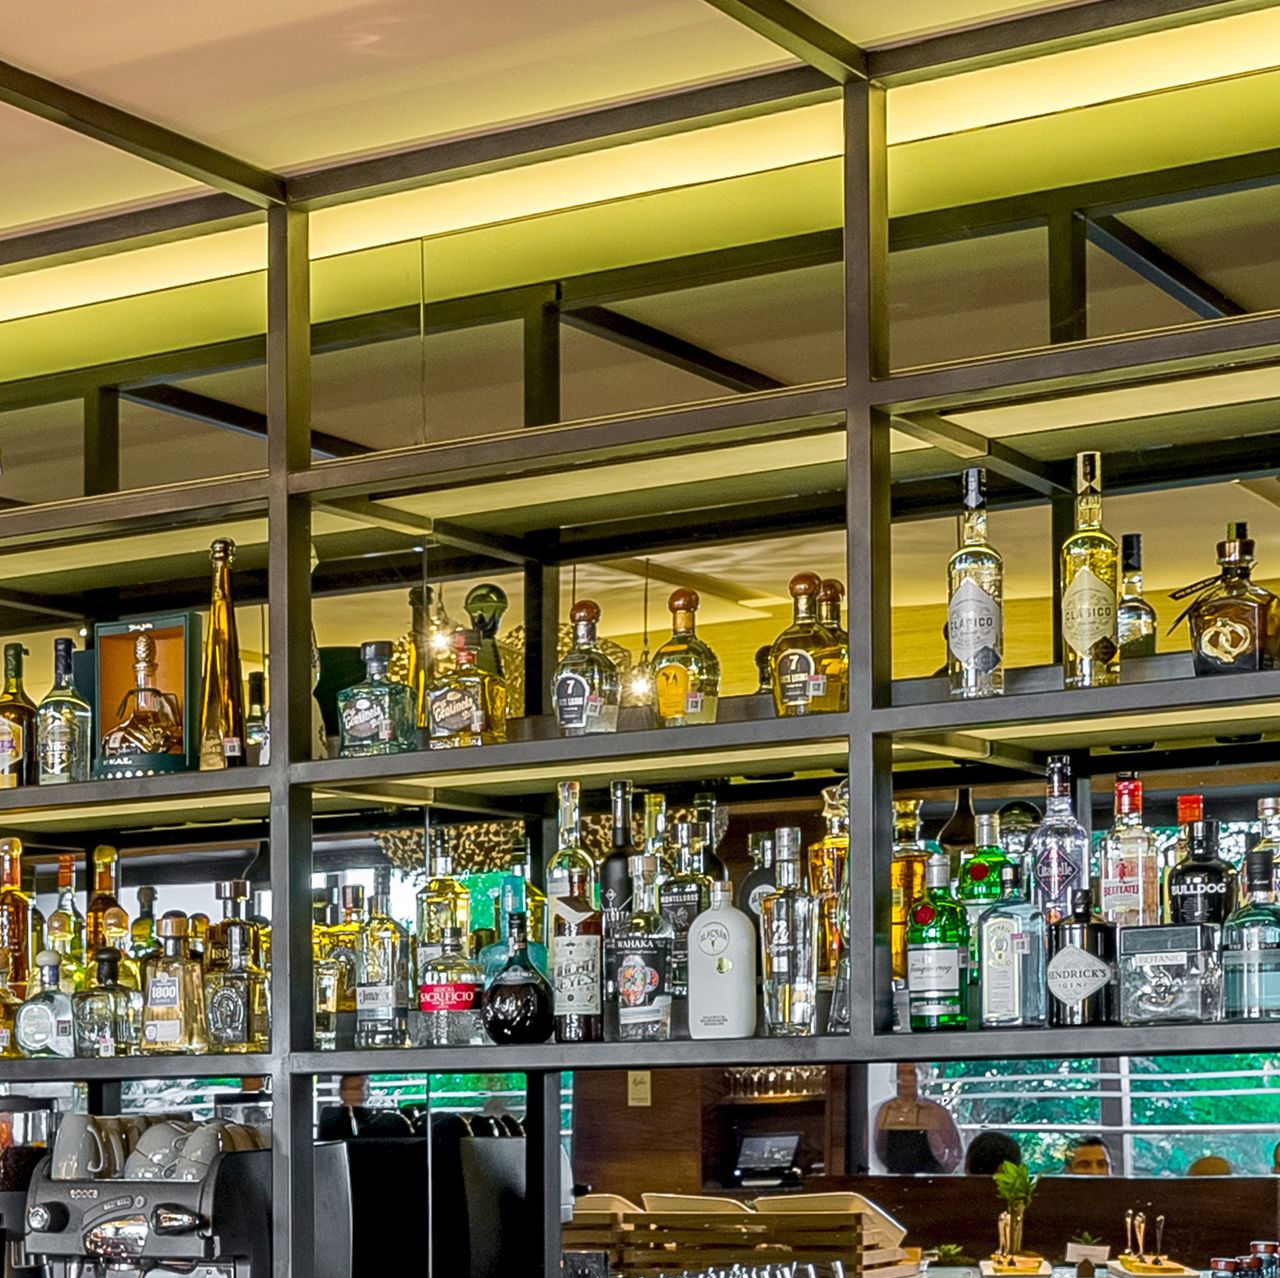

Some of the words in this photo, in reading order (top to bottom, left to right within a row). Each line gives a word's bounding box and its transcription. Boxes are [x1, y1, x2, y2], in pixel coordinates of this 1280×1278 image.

[789, 654, 800, 671] 7
[566, 679, 576, 694] 7
[1171, 883, 1226, 895] BULLDOG
[617, 939, 654, 949] WAHAKA
[212, 947, 231, 961] 180
[1049, 969, 1107, 980] ENDRICK'S
[151, 985, 176, 999] 1800
